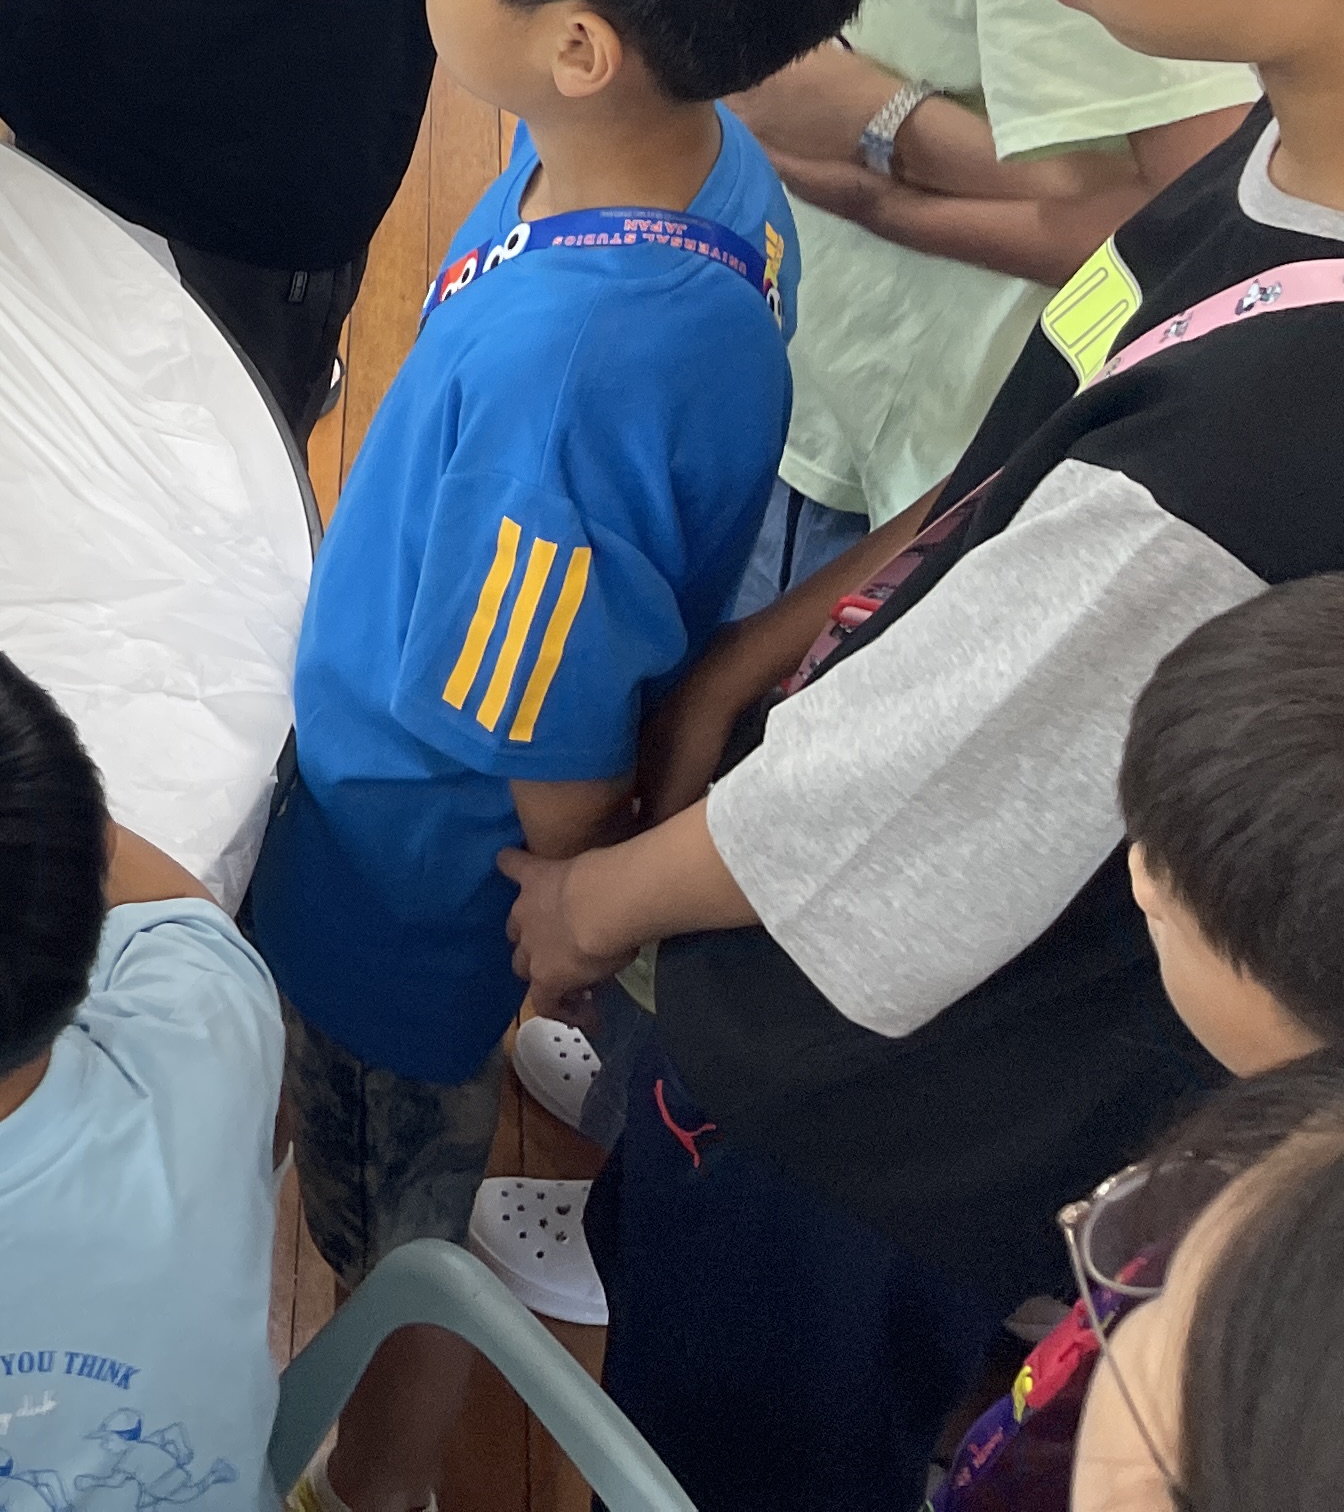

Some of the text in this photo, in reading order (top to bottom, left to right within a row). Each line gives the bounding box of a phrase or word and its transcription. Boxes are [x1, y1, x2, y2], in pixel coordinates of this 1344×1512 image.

[623, 219, 688, 235] JAPAN
[552, 233, 747, 276] UNIVERSAL STUDIOS
[0, 1350, 58, 1376] YOU
[63, 1351, 142, 1390] THINK
